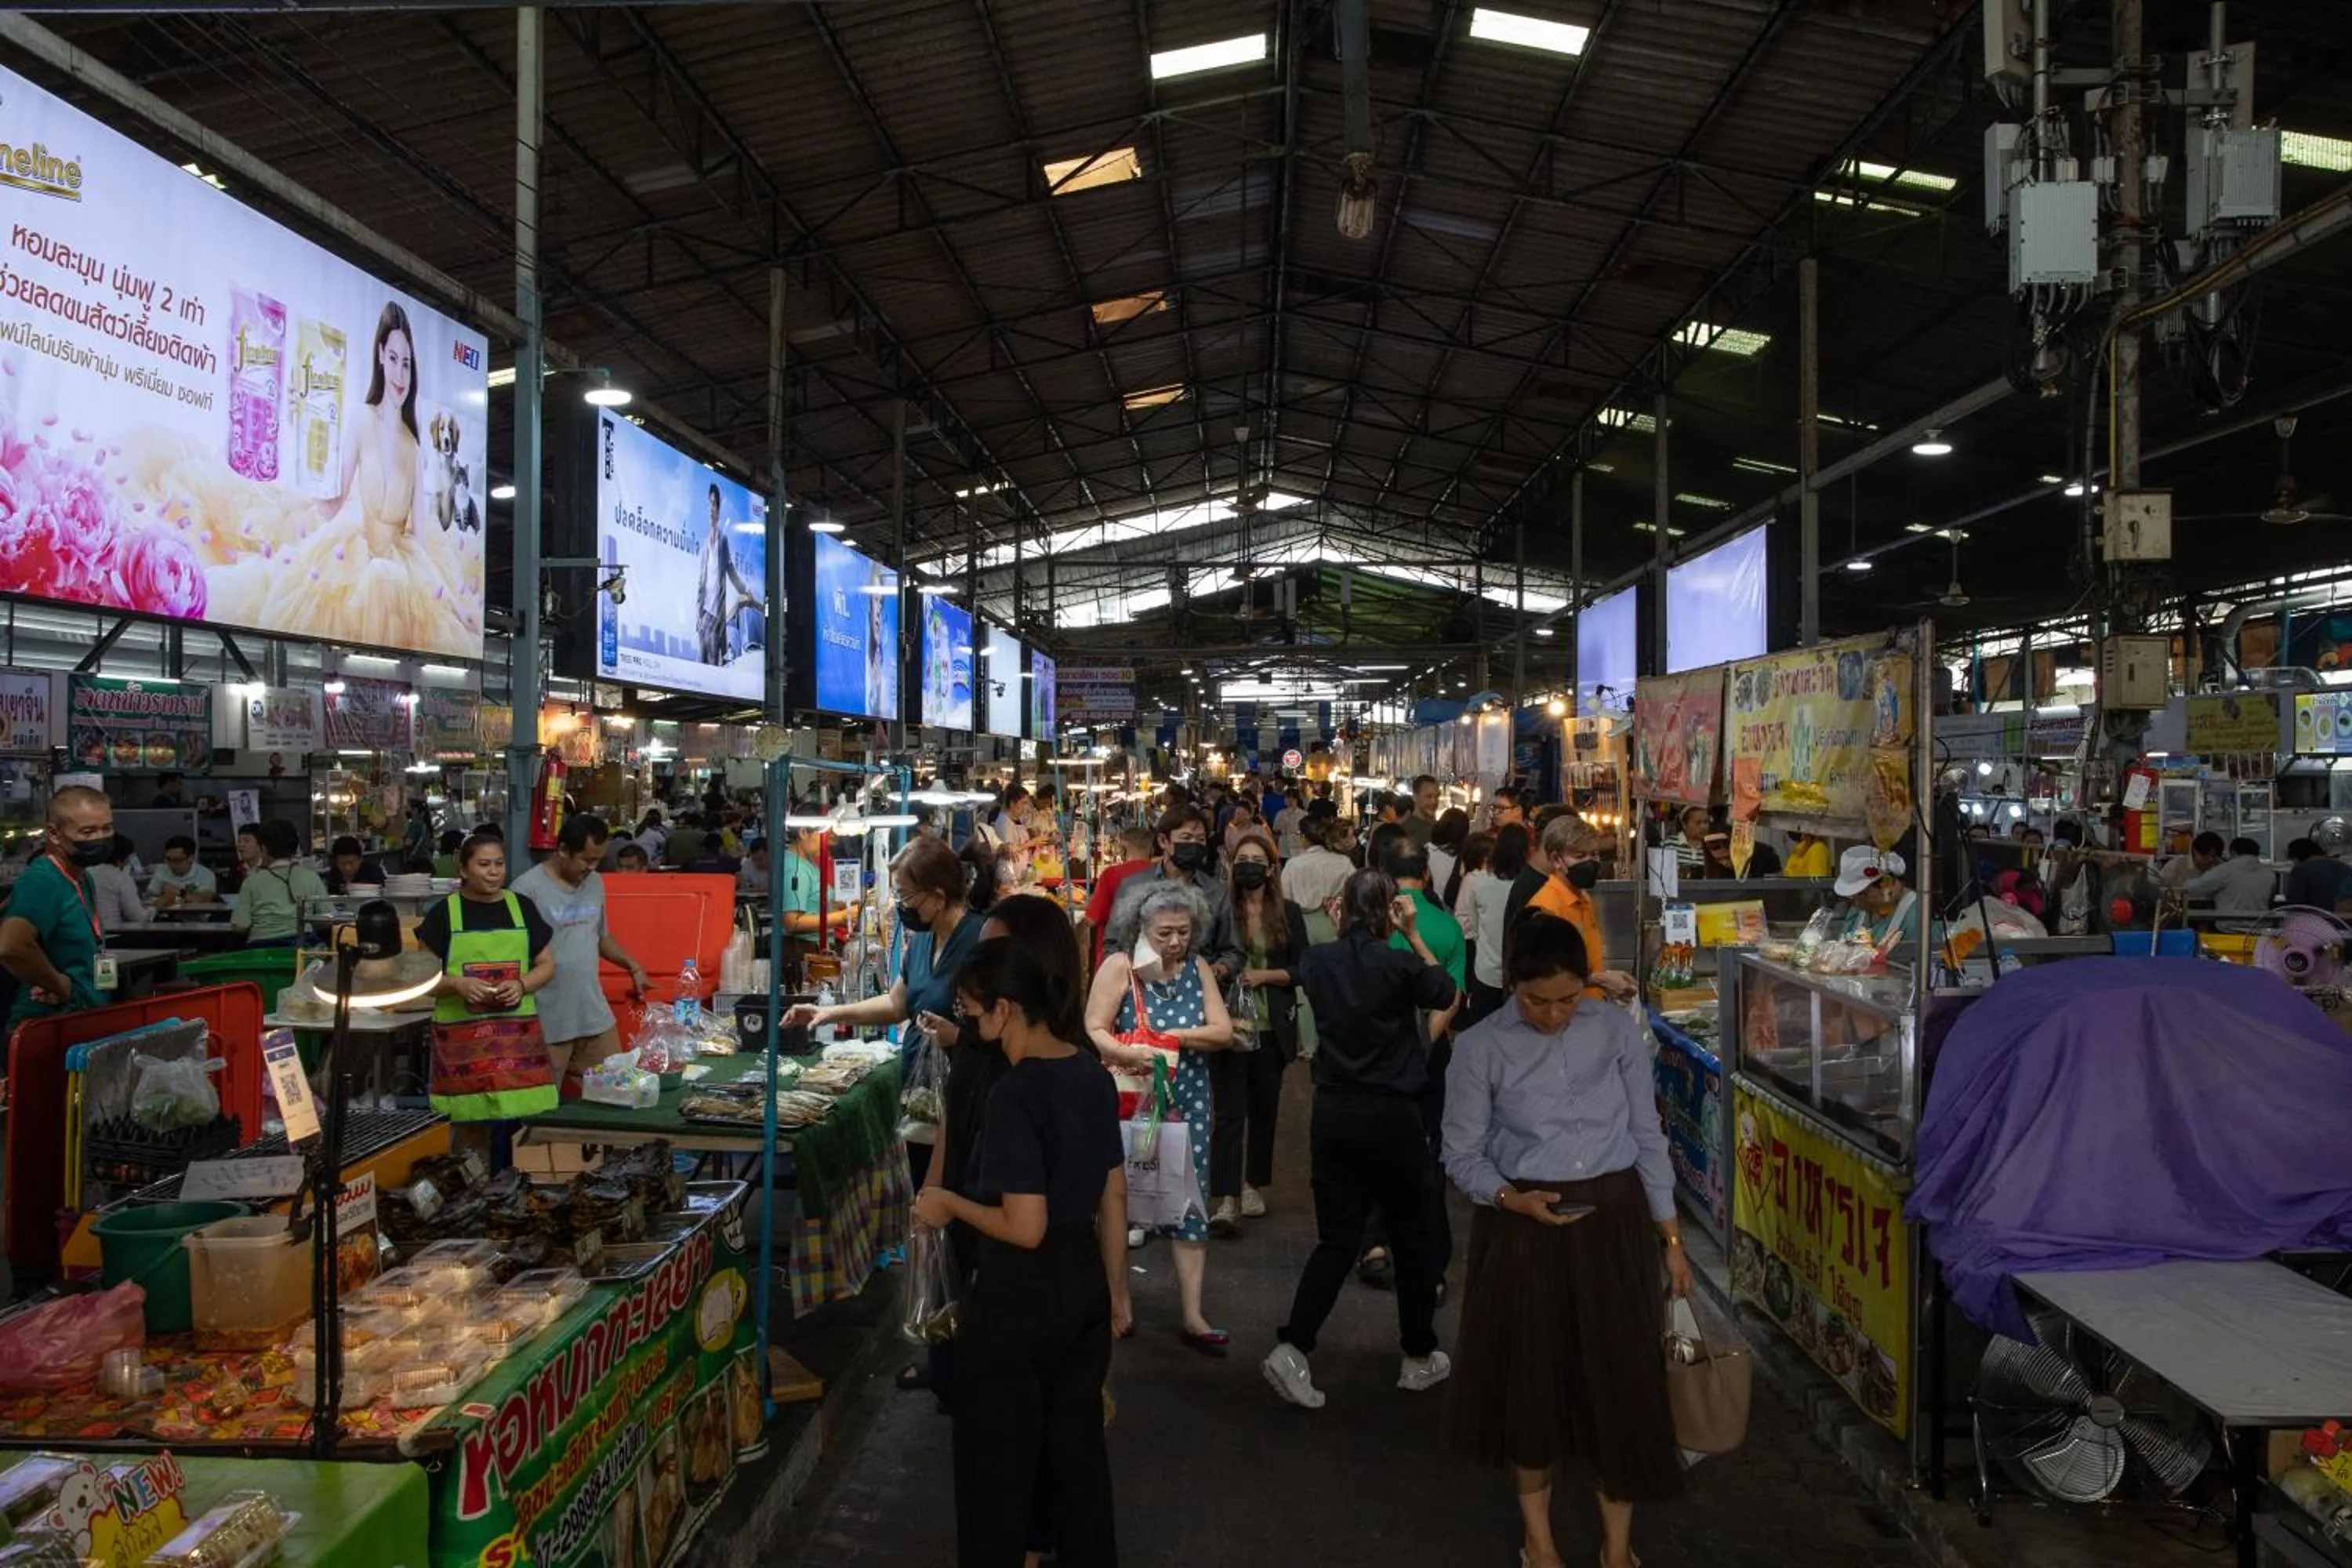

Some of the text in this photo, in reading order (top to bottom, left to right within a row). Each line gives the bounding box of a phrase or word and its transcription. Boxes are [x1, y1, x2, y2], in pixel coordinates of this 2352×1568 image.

[12, 223, 205, 326] หอมละมุน นุ่มฟู 2 เท่า
[453, 339, 479, 371] NEO
[1772, 1138, 1891, 1290] อาหารเจ
[111, 1450, 184, 1524] NEW!
